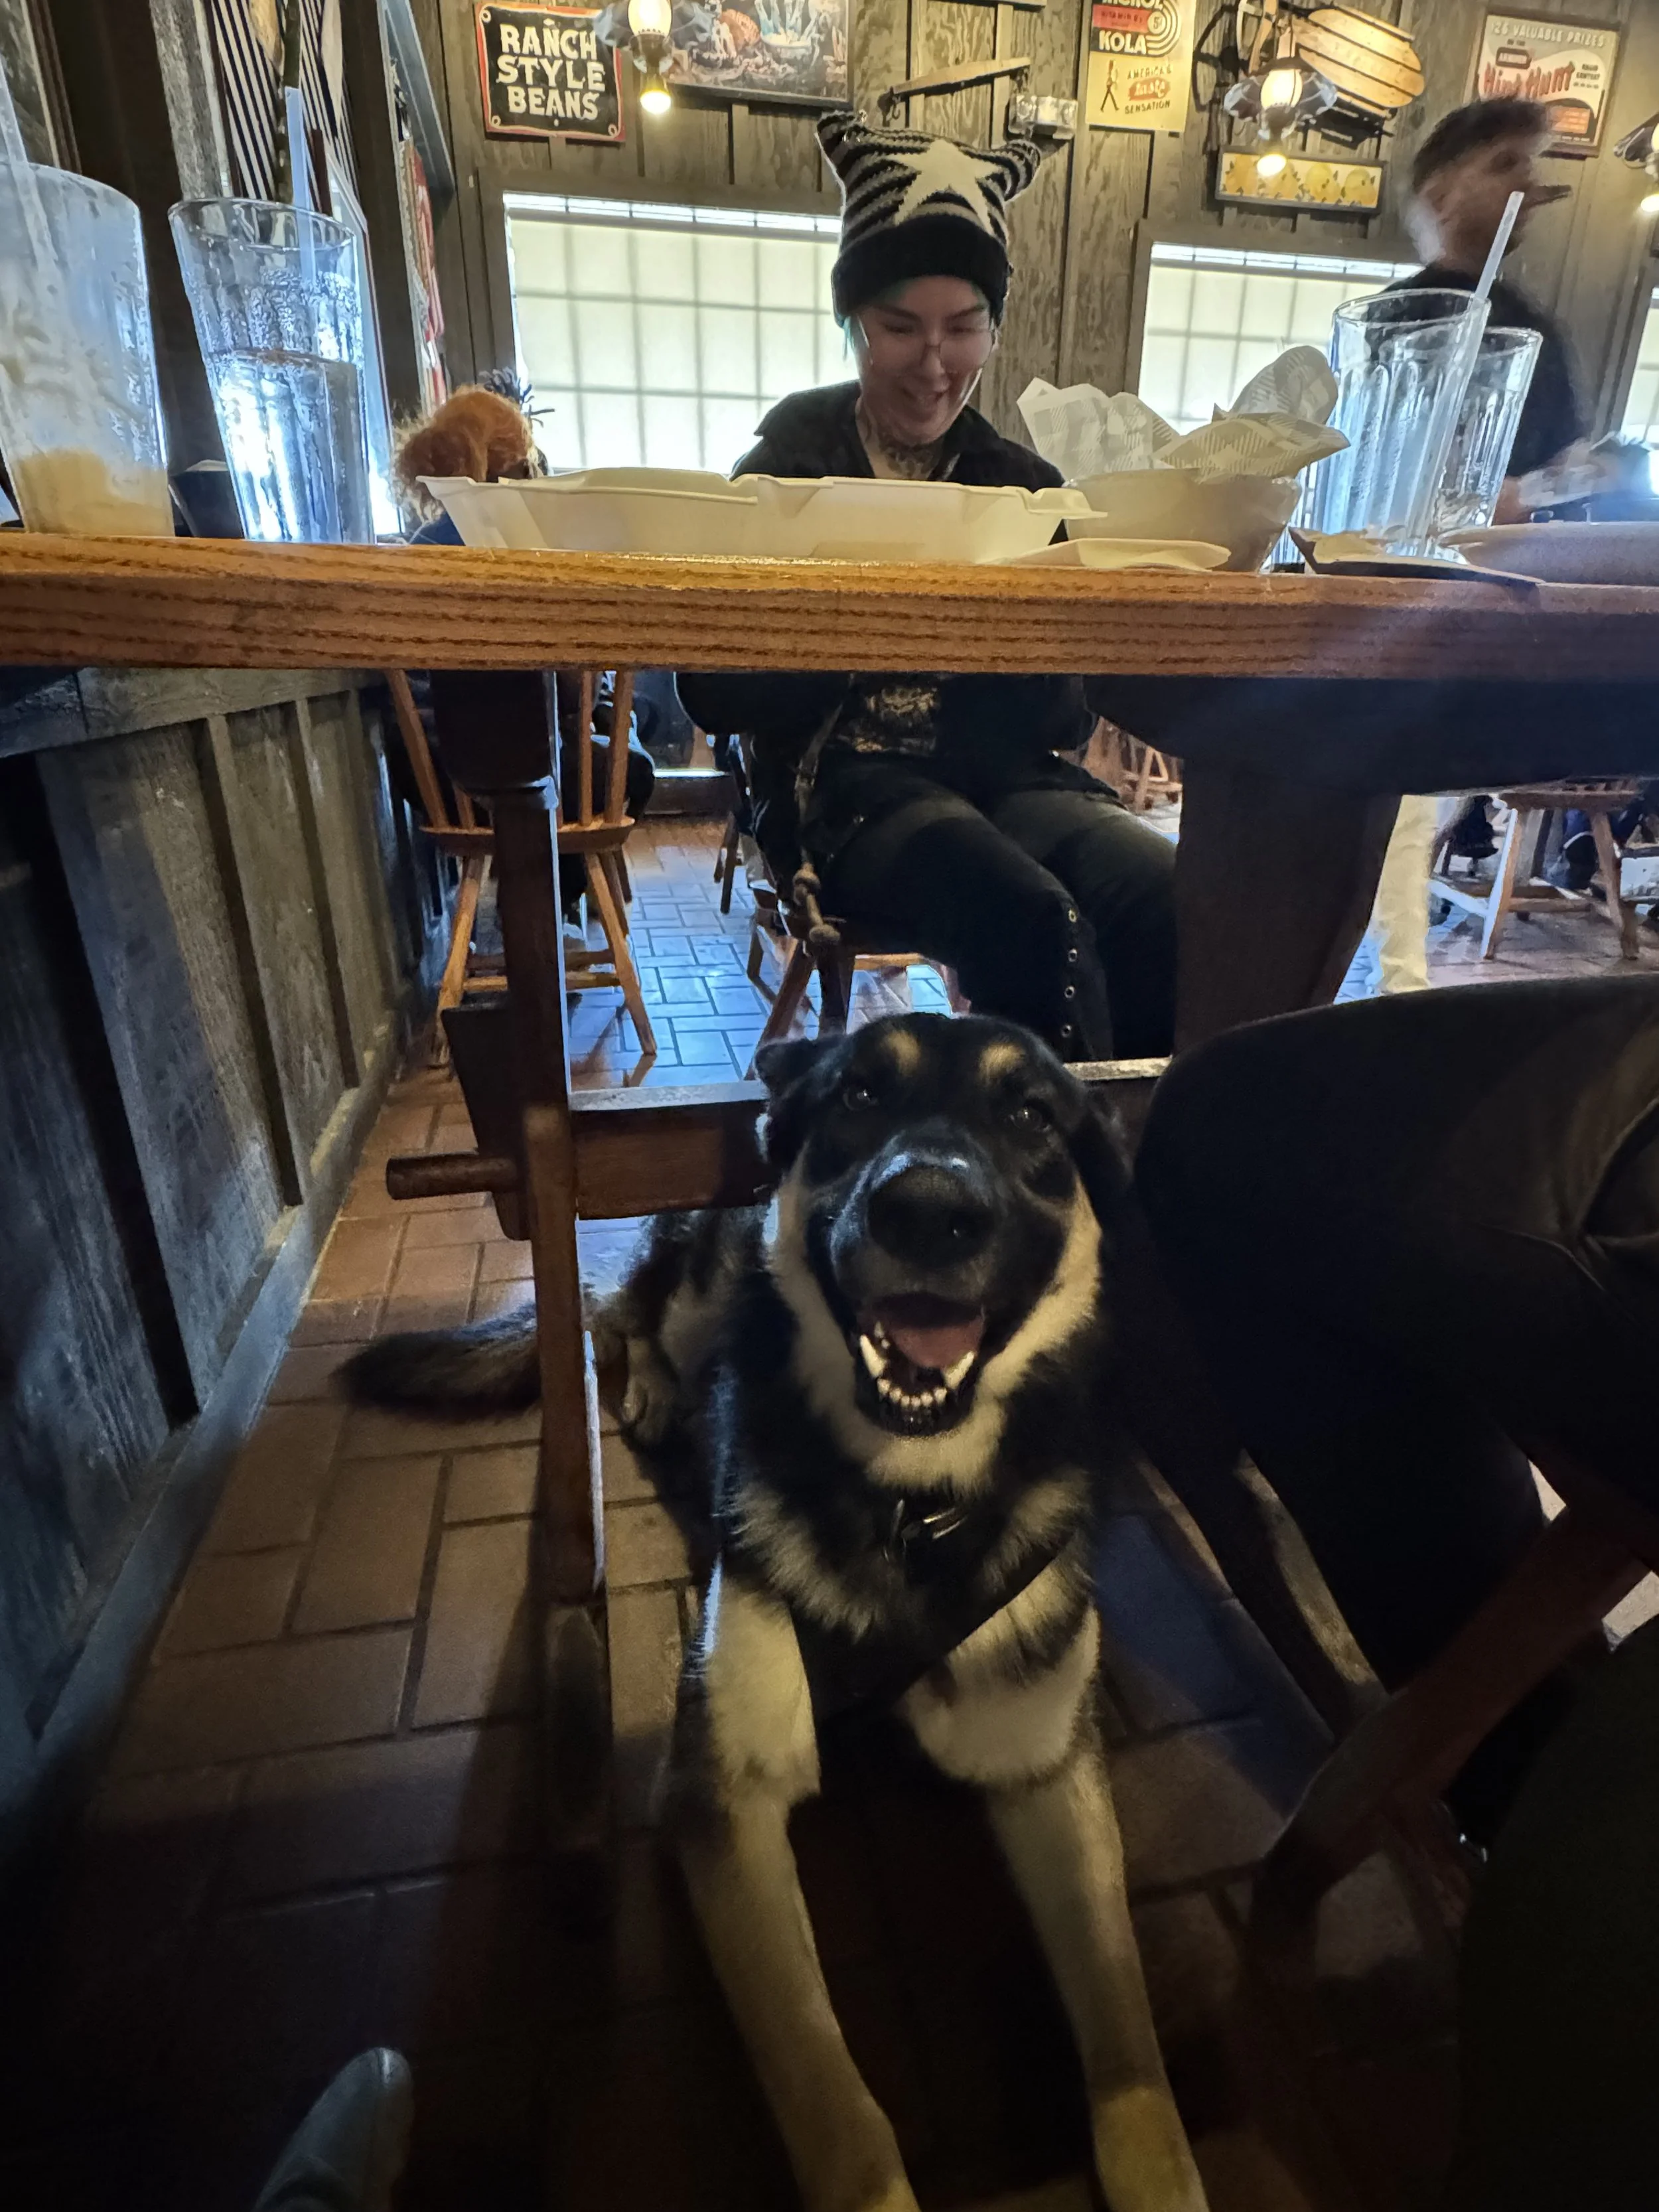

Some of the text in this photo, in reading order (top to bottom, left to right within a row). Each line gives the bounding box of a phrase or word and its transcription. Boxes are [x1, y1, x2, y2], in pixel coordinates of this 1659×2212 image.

[500, 23, 597, 60] RANCH
[1099, 30, 1147, 54] KOLA
[1514, 24, 1563, 42] VALUABLE
[1567, 33, 1605, 47] PRIZES
[496, 54, 606, 92] STYLE
[507, 85, 600, 121] BEANS
[1124, 100, 1171, 114] SENSATION
